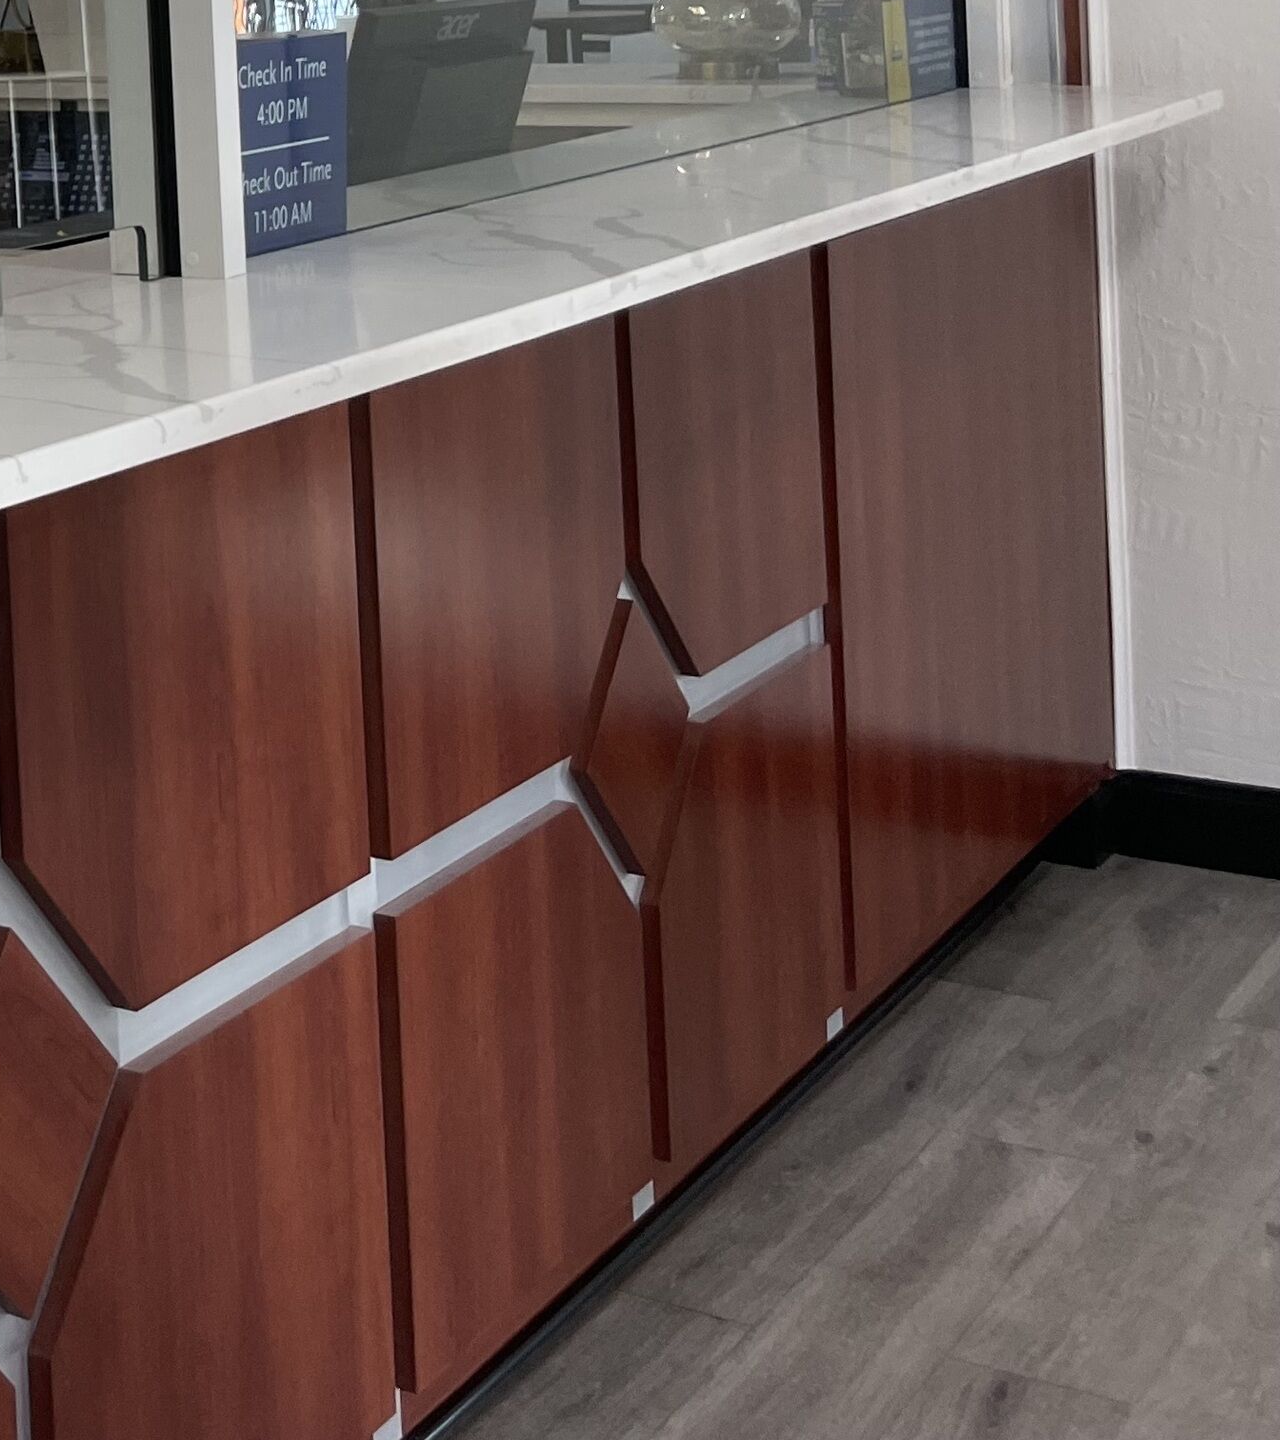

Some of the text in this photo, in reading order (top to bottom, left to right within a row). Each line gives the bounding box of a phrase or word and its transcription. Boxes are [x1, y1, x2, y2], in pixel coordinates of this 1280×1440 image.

[436, 13, 481, 41] acer
[239, 57, 327, 90] Check In Time
[257, 96, 308, 126] 4:00 PM
[242, 161, 332, 196] heck Out Time
[254, 199, 313, 234] 11:00 AM
